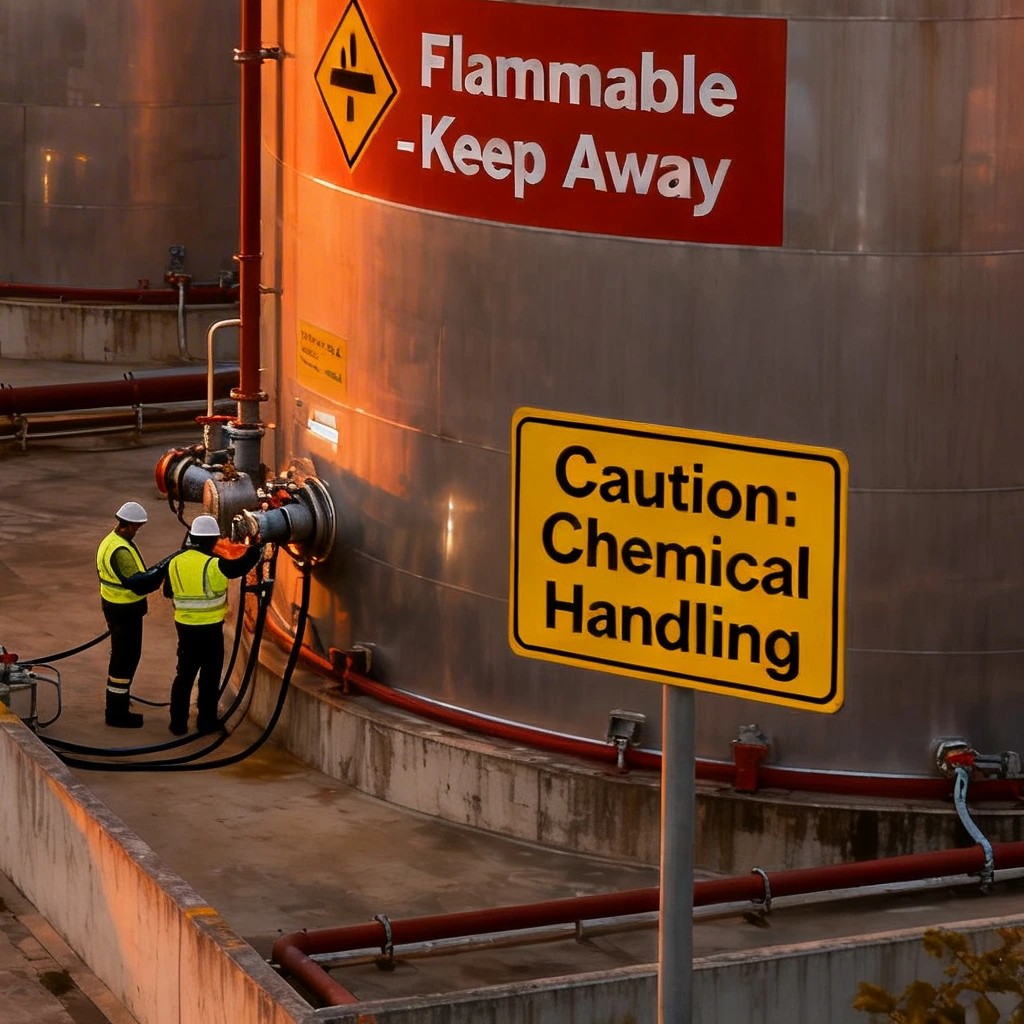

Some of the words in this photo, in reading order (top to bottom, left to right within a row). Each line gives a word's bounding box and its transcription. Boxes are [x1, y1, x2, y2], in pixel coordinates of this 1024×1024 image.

[421, 32, 738, 117] Flammable
[562, 134, 732, 217] Away
[555, 445, 797, 527] Caution:
[542, 512, 809, 599] Chemical
[545, 580, 800, 682] Handling
